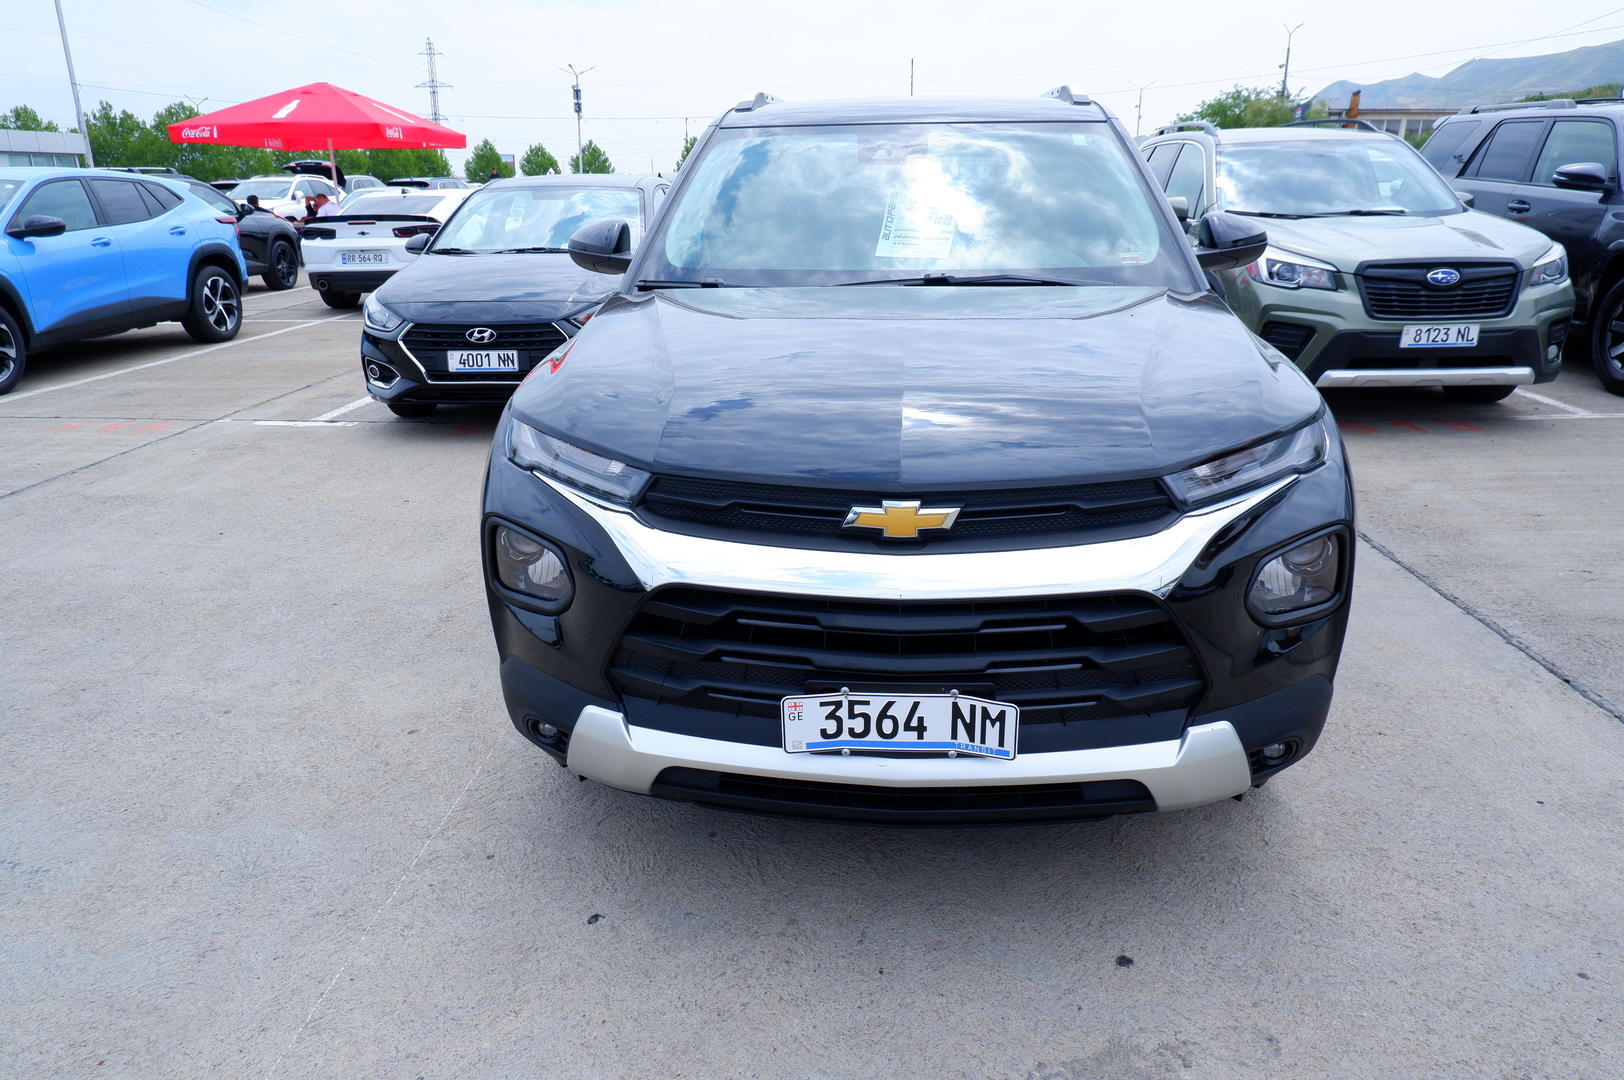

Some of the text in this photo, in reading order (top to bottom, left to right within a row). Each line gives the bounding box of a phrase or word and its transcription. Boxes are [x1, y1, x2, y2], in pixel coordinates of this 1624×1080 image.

[1413, 326, 1474, 343] 8123 NL
[459, 353, 515, 368] 4001 NN
[788, 712, 804, 721] GE
[819, 700, 1006, 748] 3564 NM
[954, 742, 996, 756] TRANSIT
